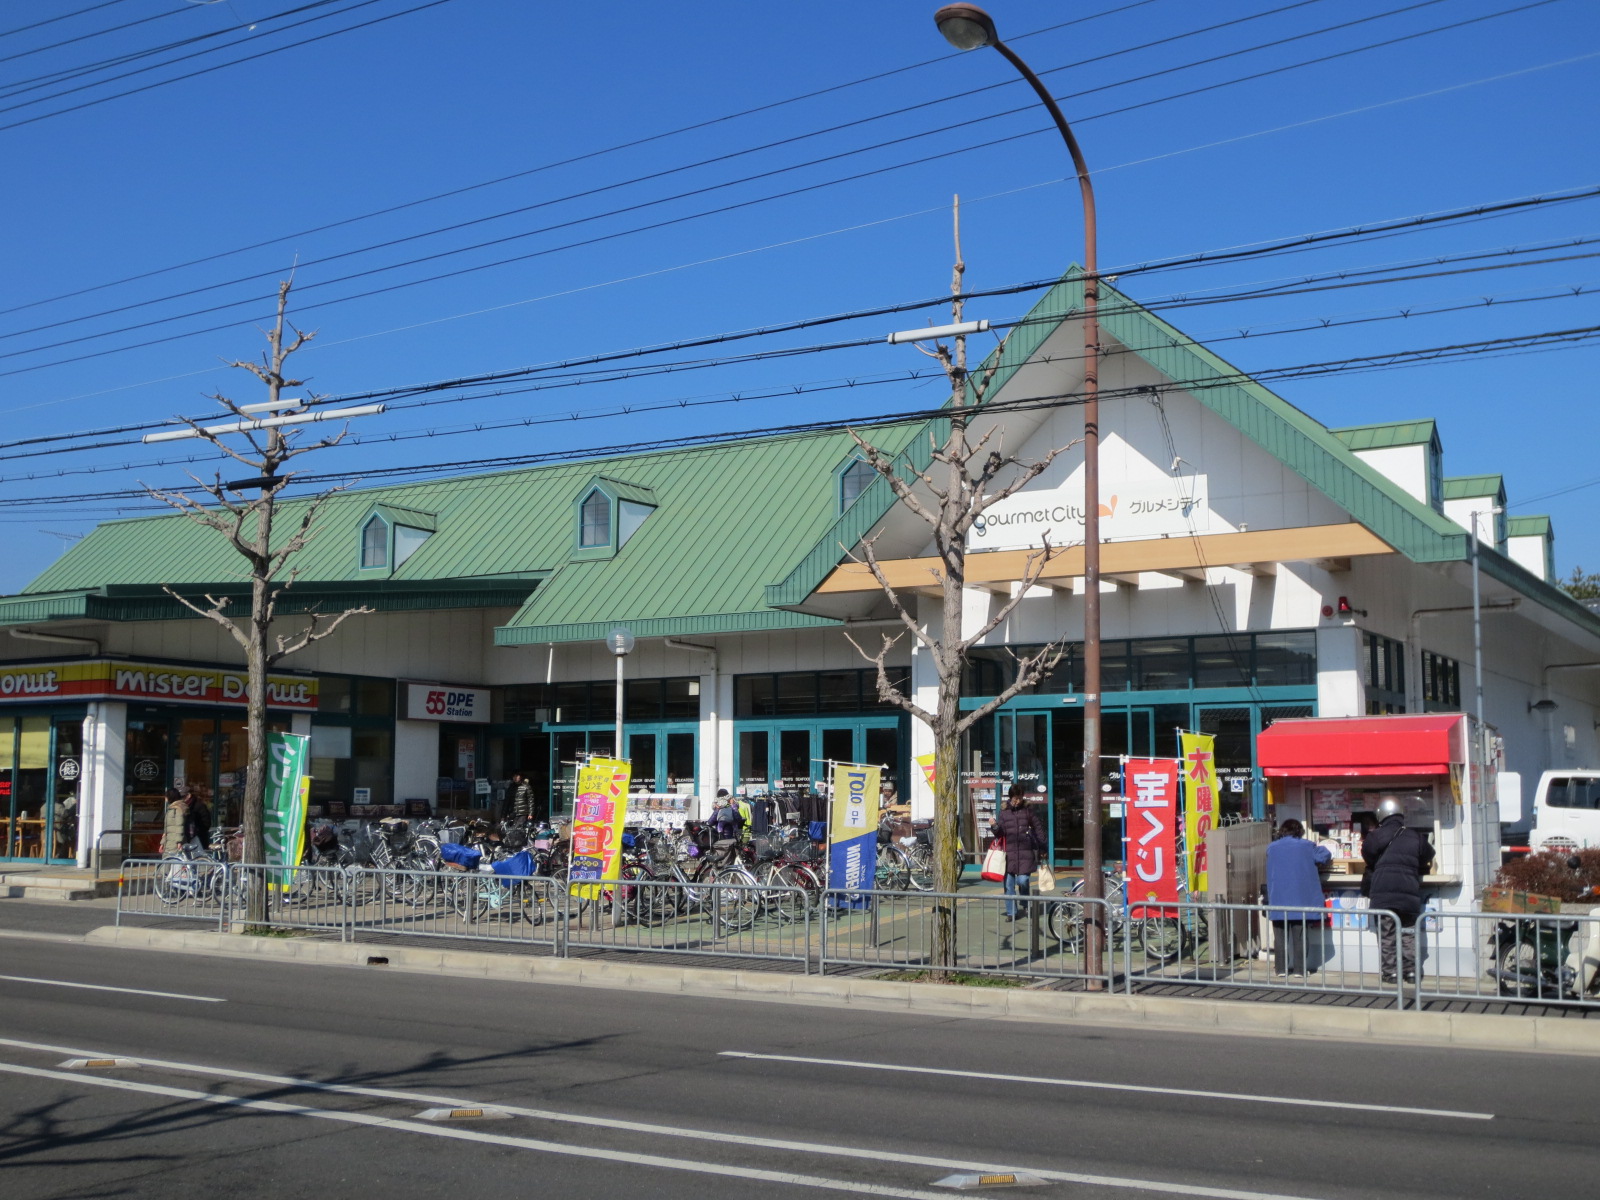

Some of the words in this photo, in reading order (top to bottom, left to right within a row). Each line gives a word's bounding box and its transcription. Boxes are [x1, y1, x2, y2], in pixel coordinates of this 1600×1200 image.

[1129, 496, 1203, 515] グルメシティ
[1, 669, 59, 694] onut
[116, 670, 215, 696] Mister
[426, 690, 446, 715] 55
[447, 692, 475, 707] DPE
[446, 706, 473, 717] Station
